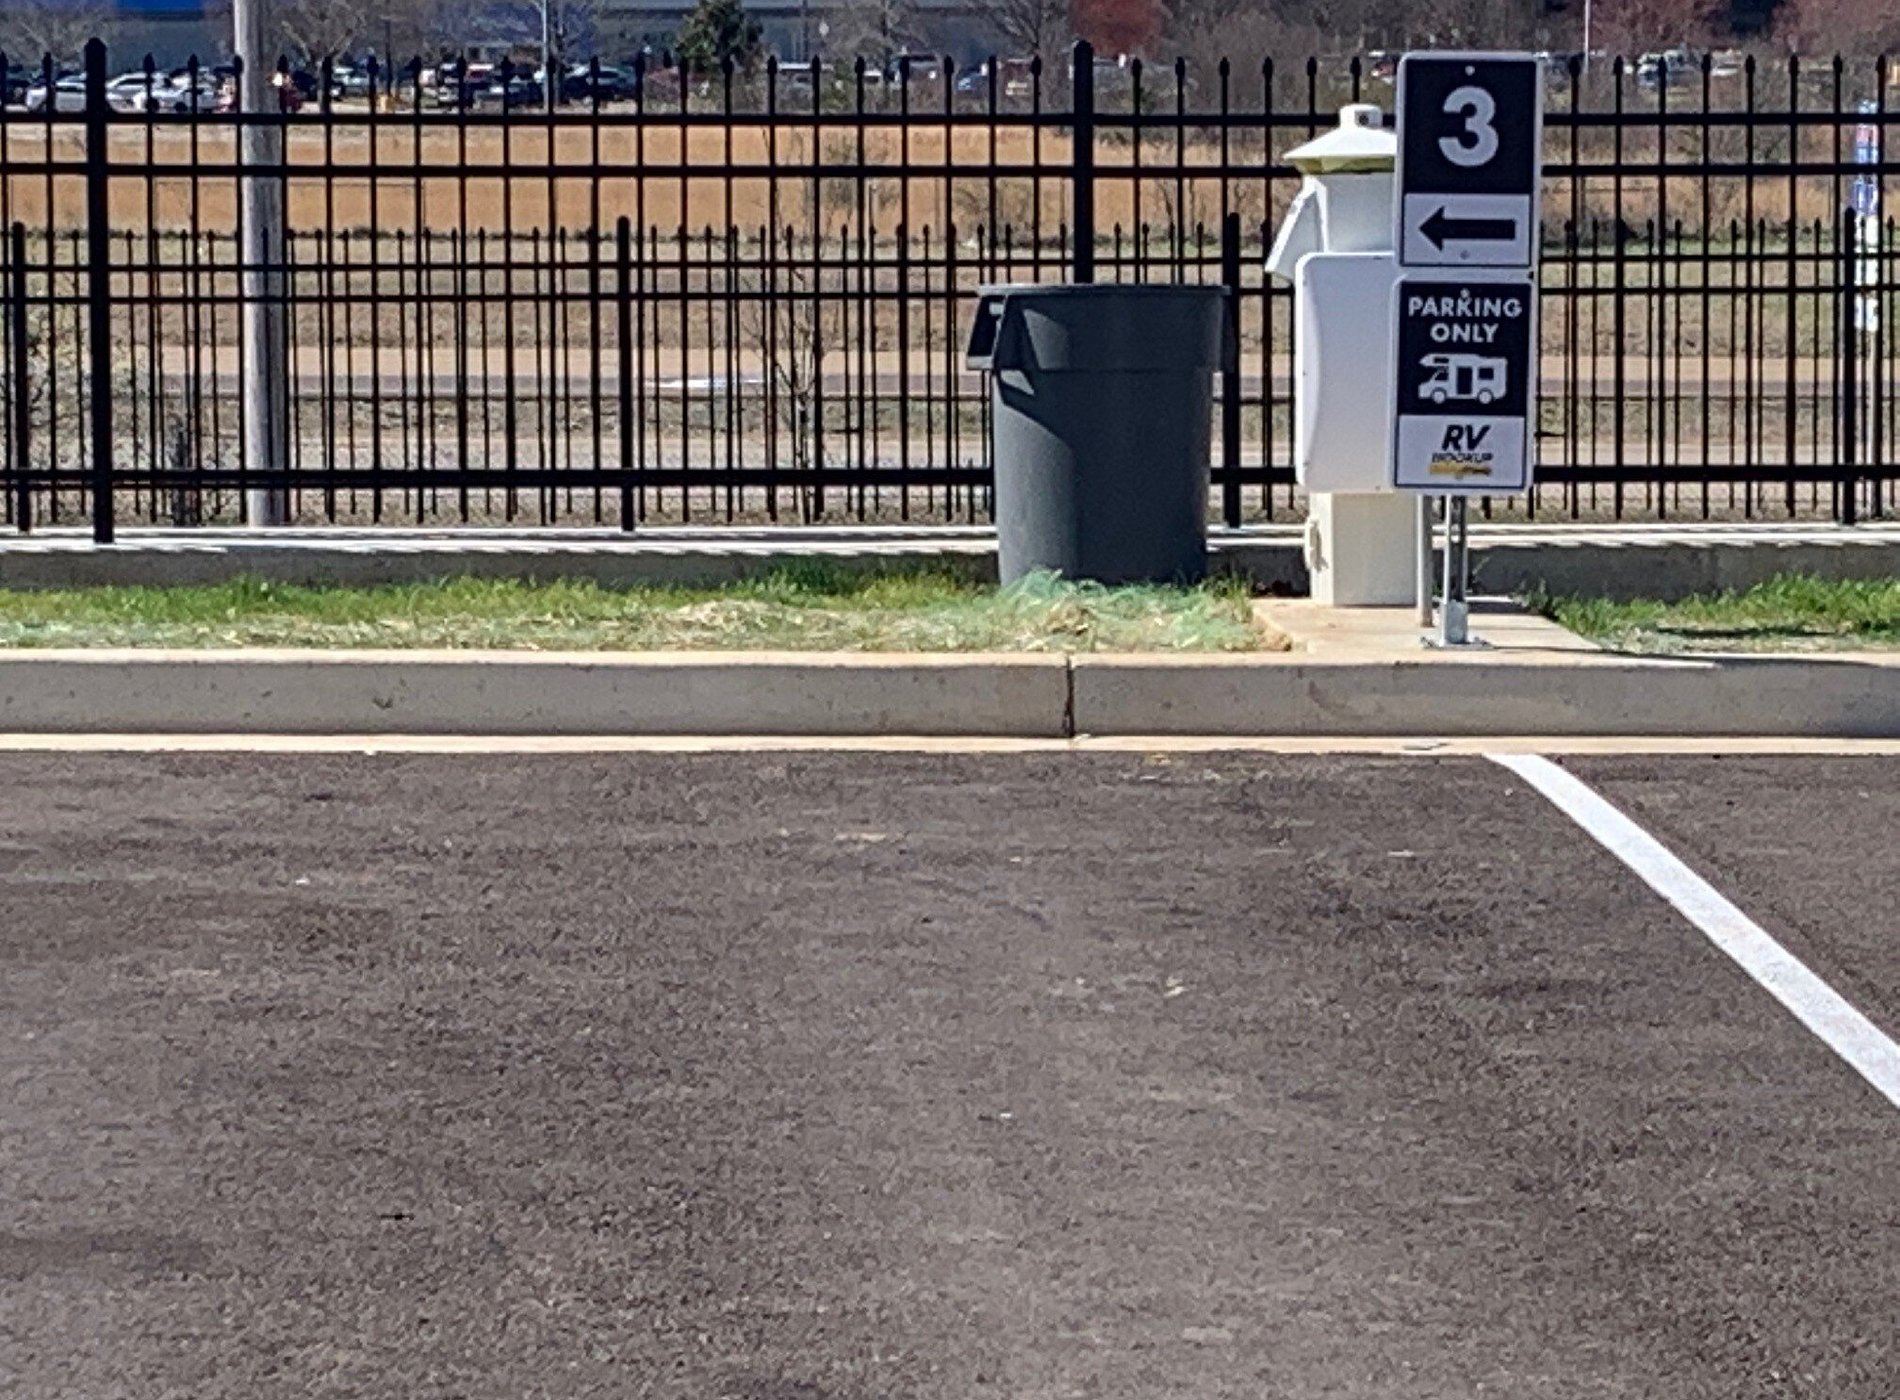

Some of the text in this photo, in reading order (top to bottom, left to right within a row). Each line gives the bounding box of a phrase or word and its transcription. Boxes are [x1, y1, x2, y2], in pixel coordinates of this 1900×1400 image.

[1438, 85, 1499, 167] 3
[1408, 296, 1523, 318] PARKING
[1430, 323, 1499, 343] ONLY
[1441, 424, 1491, 451] RV
